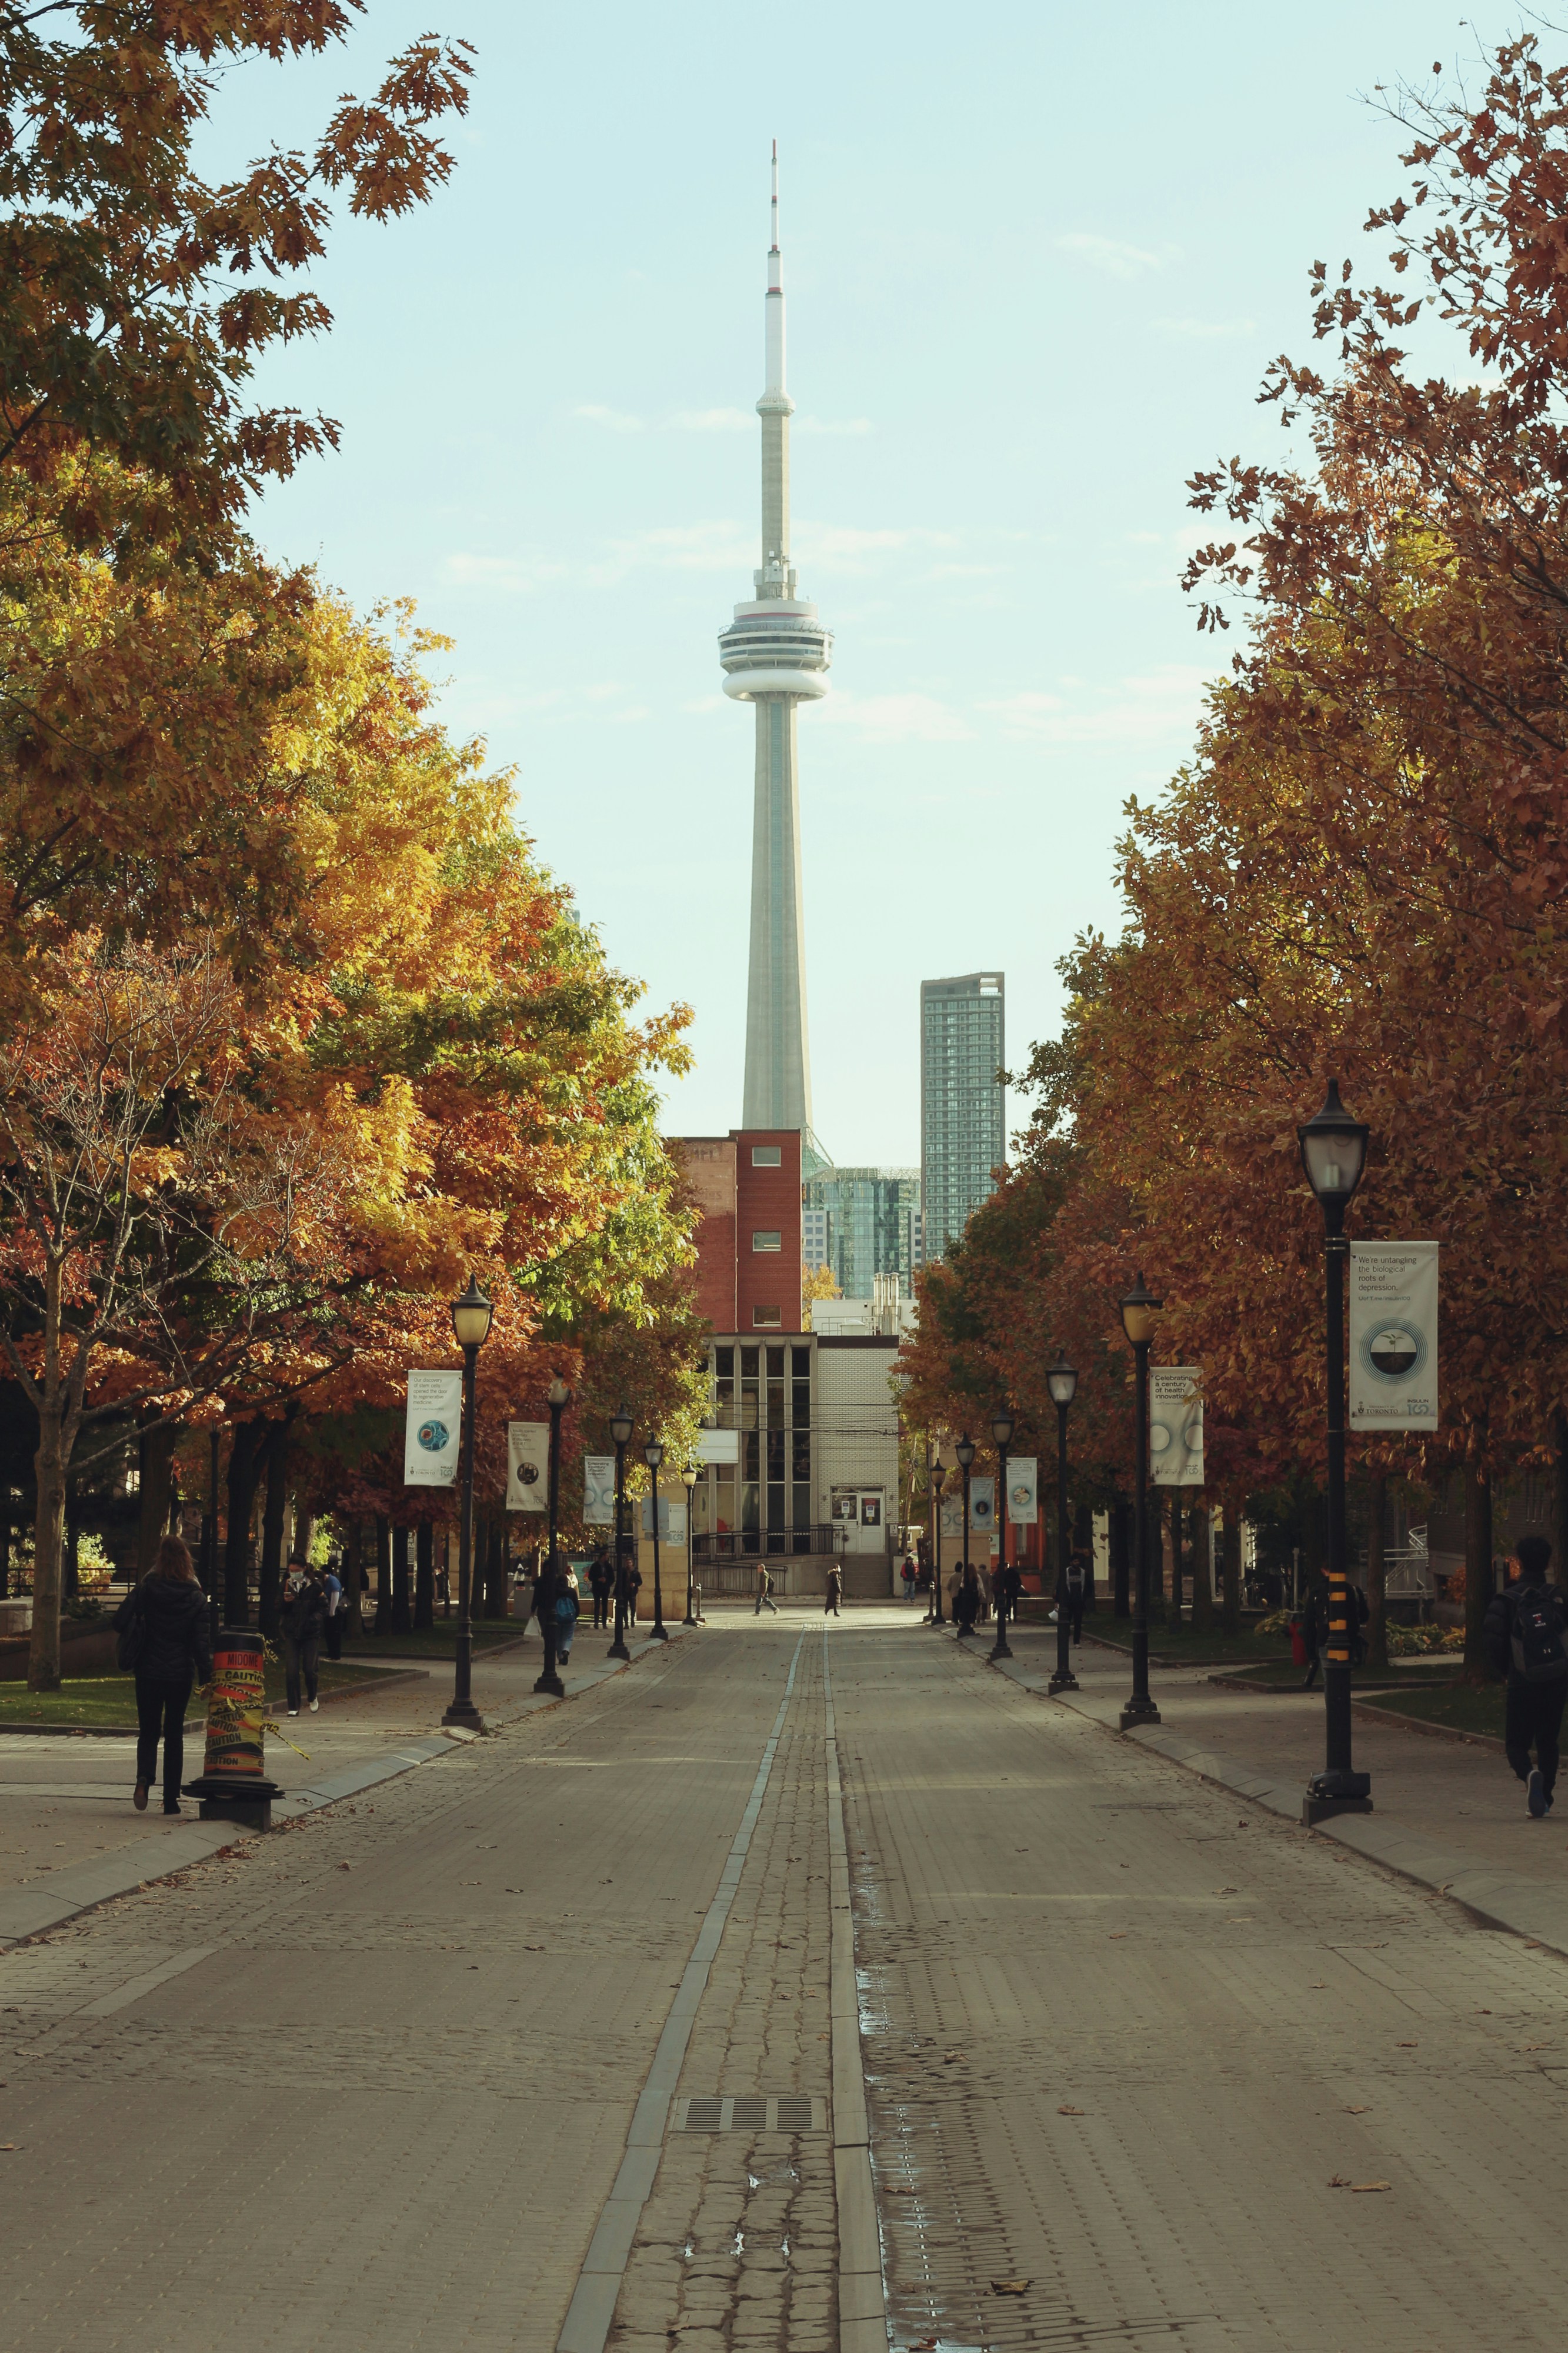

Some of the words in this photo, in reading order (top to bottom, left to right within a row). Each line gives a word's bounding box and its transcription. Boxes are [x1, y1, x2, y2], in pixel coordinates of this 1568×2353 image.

[1380, 1257, 1417, 1265] untangling
[1372, 1265, 1405, 1274] biological
[228, 1654, 258, 1667] MIDOME
